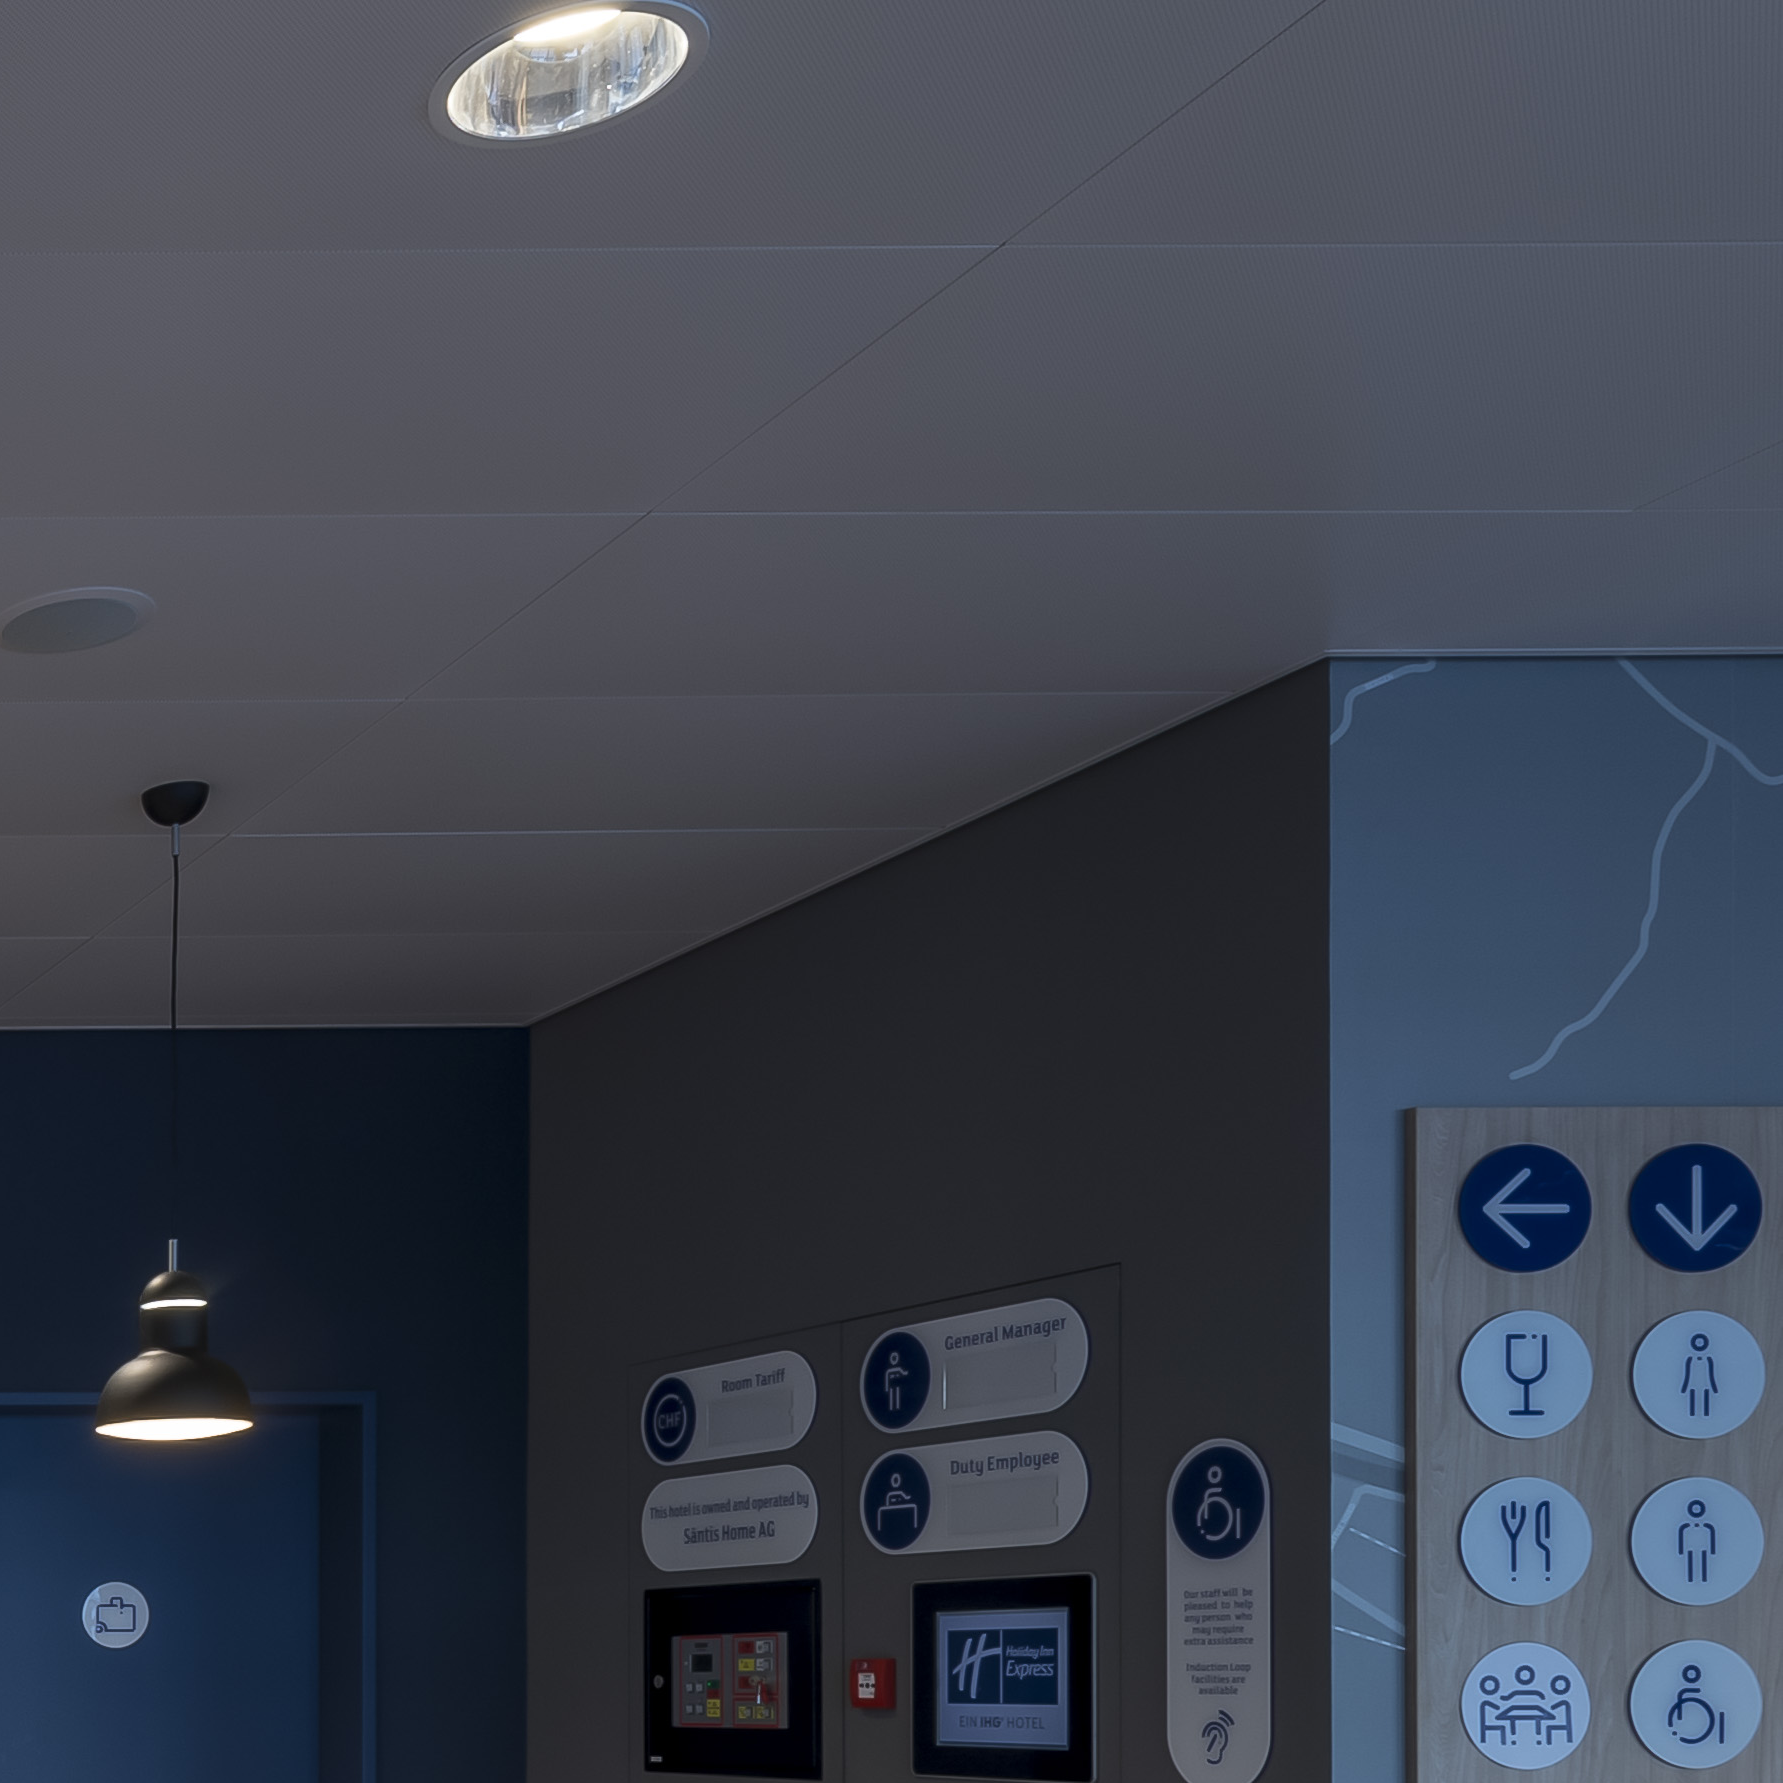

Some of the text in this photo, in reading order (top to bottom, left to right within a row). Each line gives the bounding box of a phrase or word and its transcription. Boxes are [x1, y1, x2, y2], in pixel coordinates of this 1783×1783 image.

[945, 1317, 1066, 1350] General Manager
[722, 1369, 786, 1393] Room Tariff
[658, 1411, 681, 1429] CHF
[951, 1451, 1060, 1476] Duty Employee
[650, 1491, 809, 1519] This hotel is owned and operated by
[684, 1520, 776, 1544] Säntis Home AG
[1184, 1588, 1253, 1599] Our staff will be
[1184, 1600, 1254, 1612] pleased to help
[1185, 1612, 1253, 1624] any person who
[1192, 1626, 1211, 1635] may
[1184, 1636, 1254, 1646] extra assistance
[1006, 1660, 1055, 1680] Express
[1186, 1663, 1251, 1672] Induction Loop
[1232, 1676, 1246, 1684] are
[1199, 1686, 1238, 1695] available
[959, 1716, 977, 1728] EIN
[1007, 1717, 1045, 1729] HOTEL
